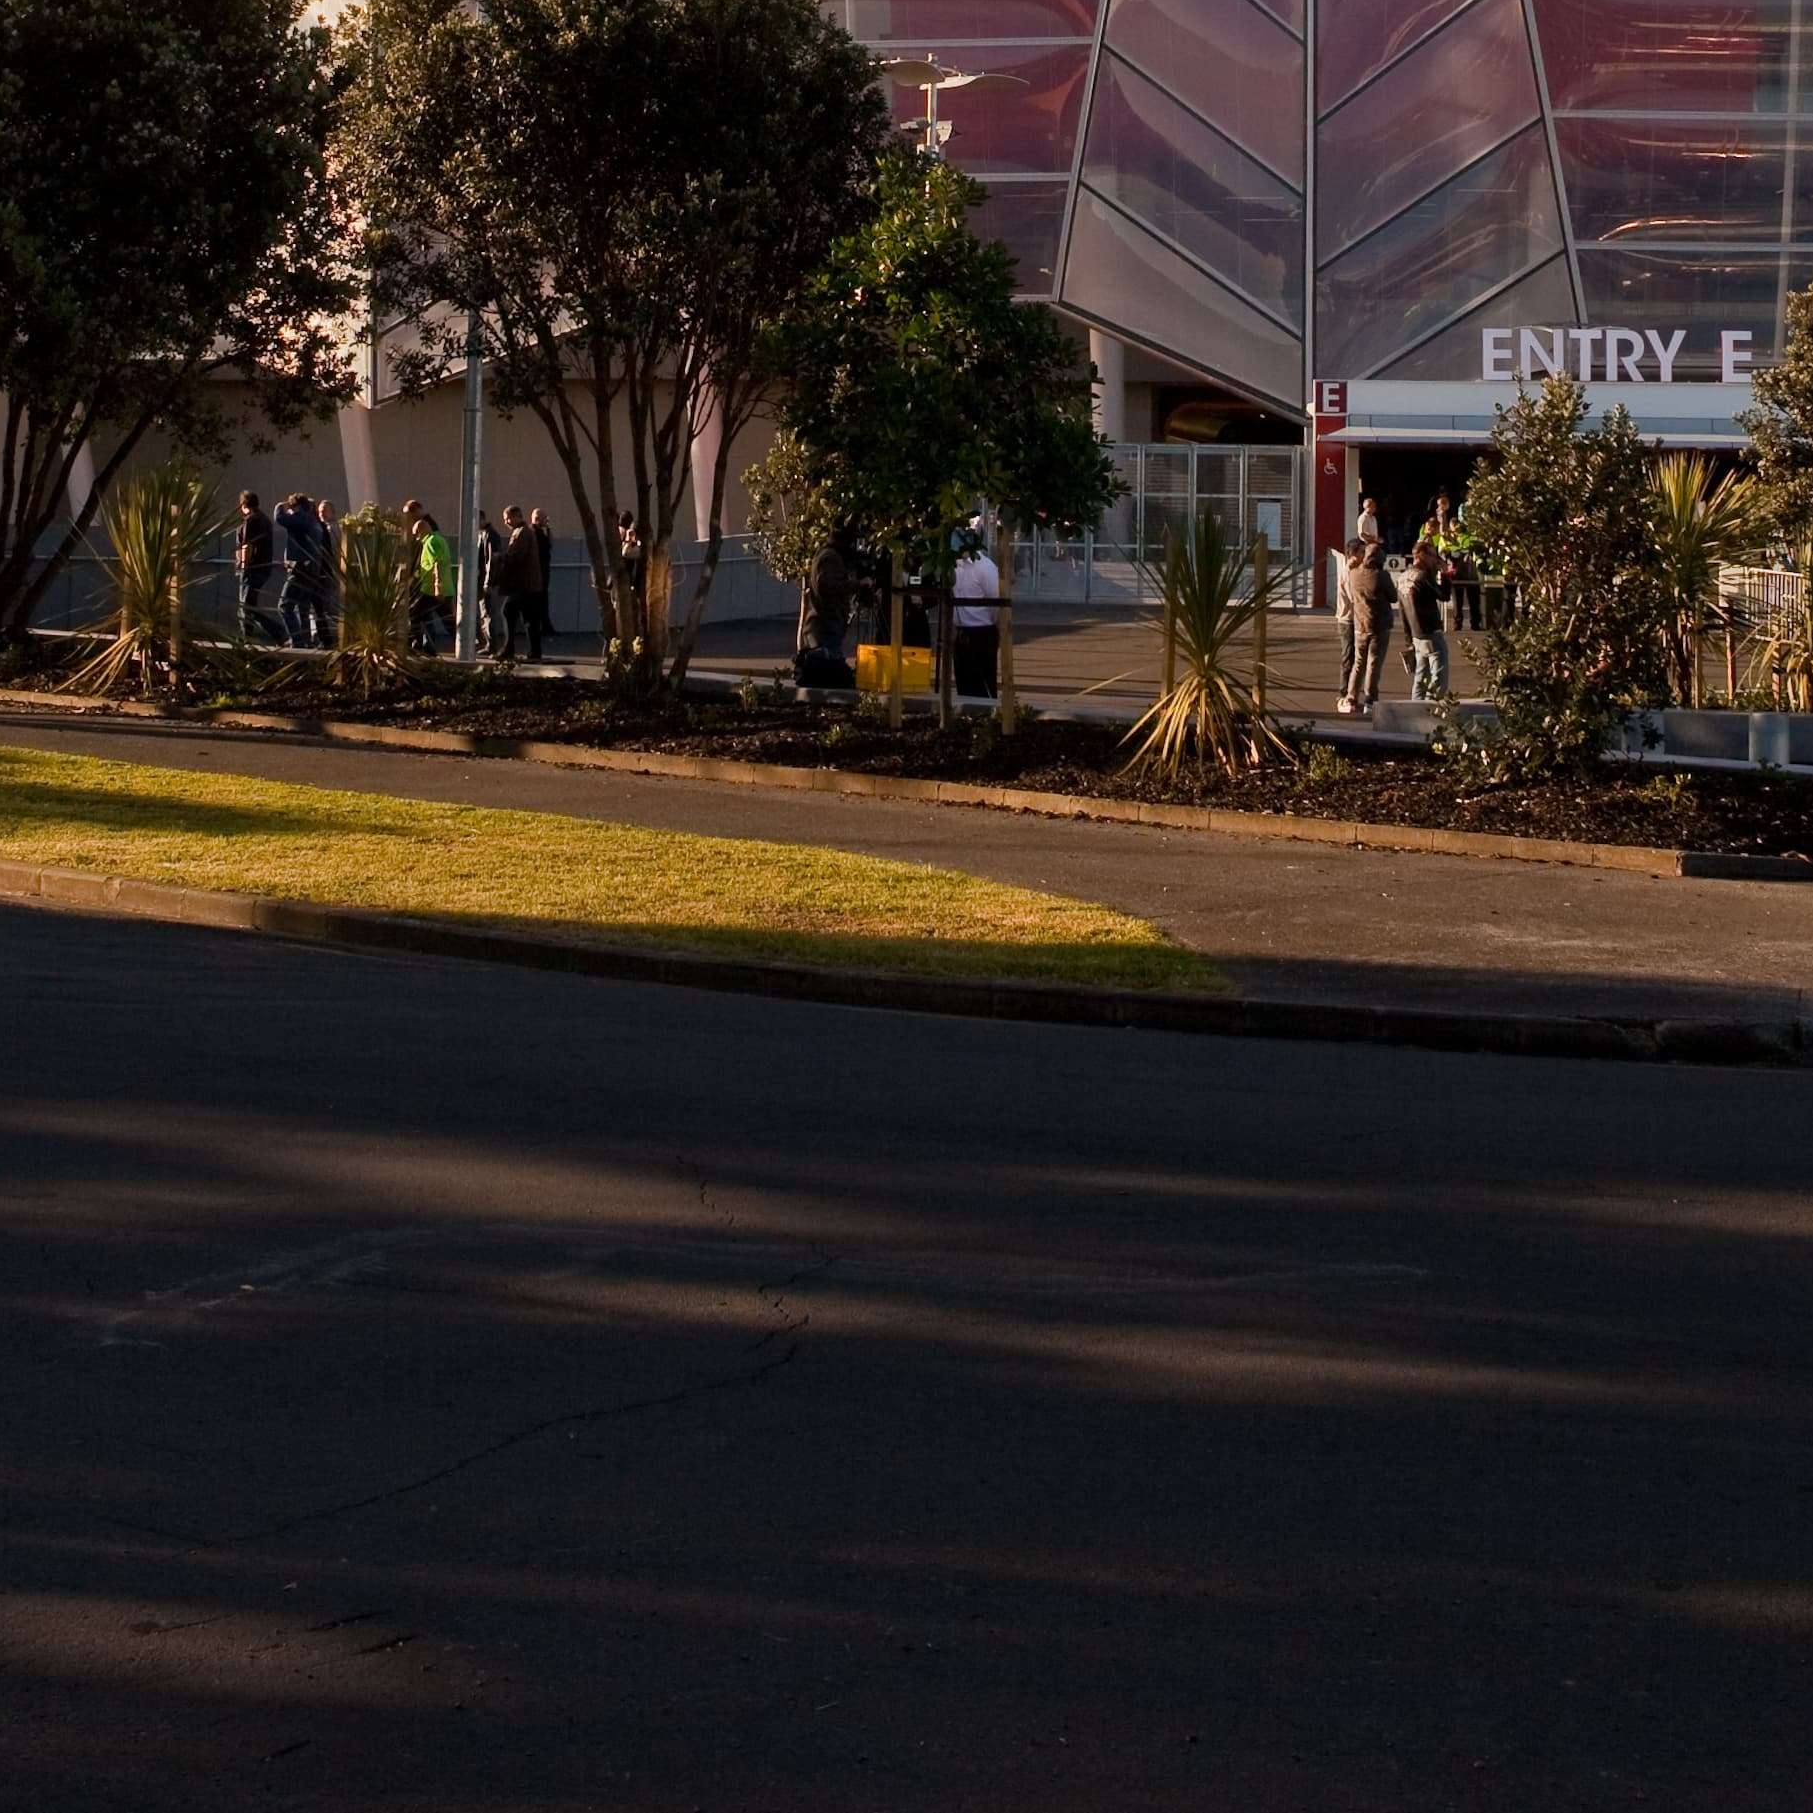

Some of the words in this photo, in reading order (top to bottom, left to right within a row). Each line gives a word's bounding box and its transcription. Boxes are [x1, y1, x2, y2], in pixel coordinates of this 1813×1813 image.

[1482, 327, 1686, 382] ENTRY
[1721, 330, 1753, 383] E
[1322, 383, 1340, 413] E
